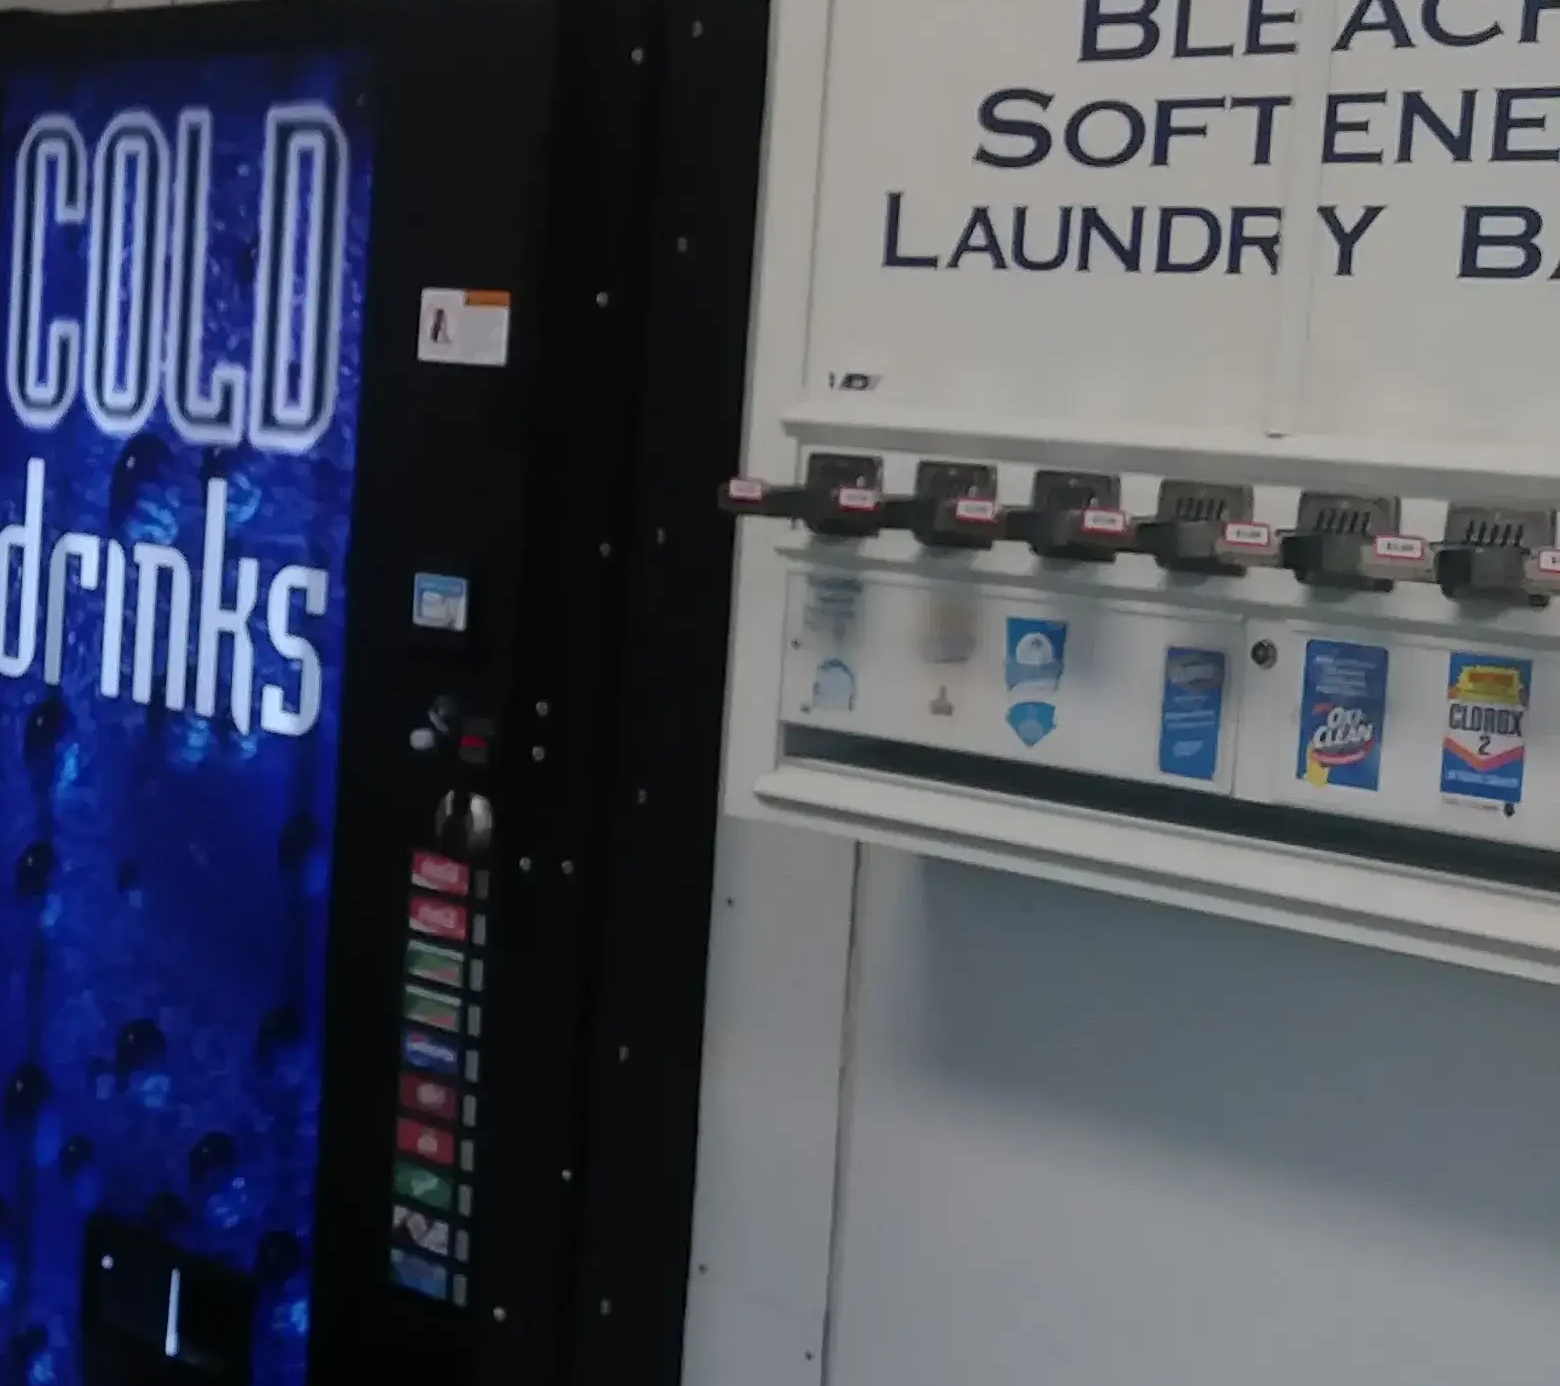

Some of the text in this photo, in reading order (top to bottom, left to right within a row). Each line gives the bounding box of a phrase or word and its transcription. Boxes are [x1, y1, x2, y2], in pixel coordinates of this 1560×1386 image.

[972, 87, 1560, 169] SOFTENE
[7, 100, 349, 453] COLD
[881, 191, 1560, 281] LAUNDRY B
[1476, 735, 1492, 756] 2
